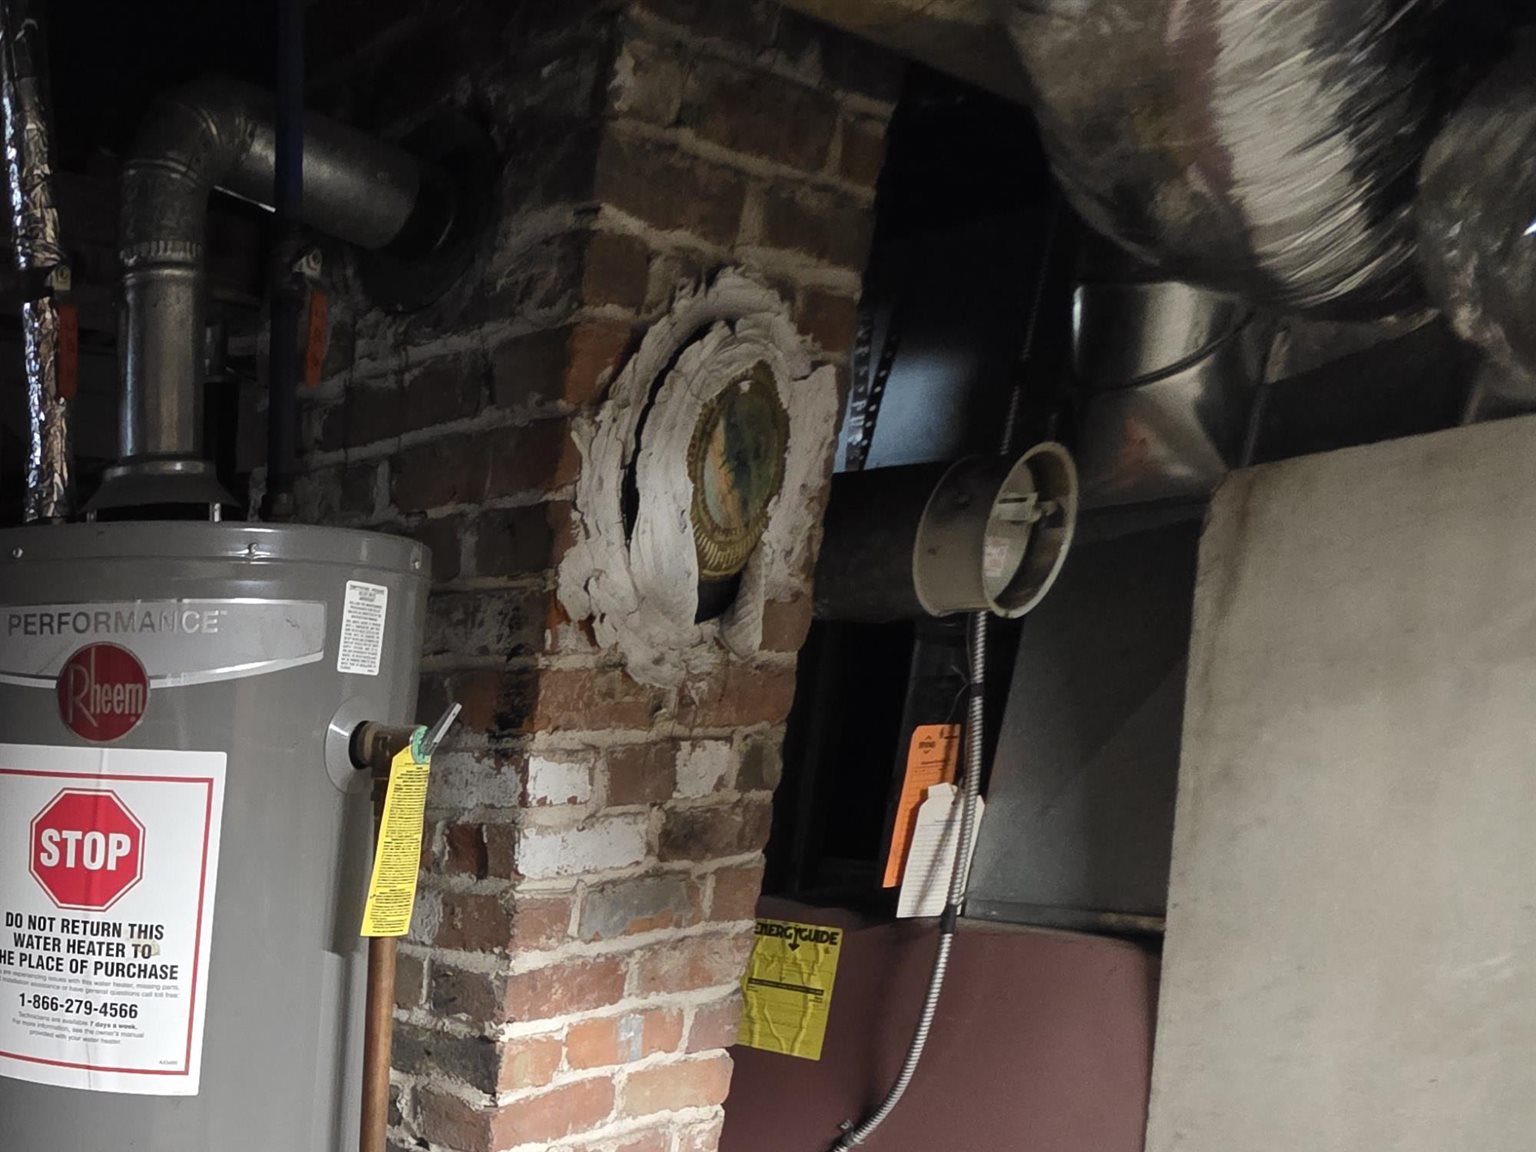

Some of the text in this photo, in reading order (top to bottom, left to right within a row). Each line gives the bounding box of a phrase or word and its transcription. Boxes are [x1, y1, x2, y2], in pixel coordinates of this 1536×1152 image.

[69, 647, 143, 728] Rheem
[40, 828, 131, 871] STOP
[5, 912, 164, 940] DO NOT RETURN THIS
[13, 932, 152, 960] WATER HEATER TO
[19, 953, 64, 973] PLACE
[69, 958, 88, 975] OF
[93, 961, 179, 980] PURCHASE
[19, 992, 138, 1019] 1-866-279-4566
